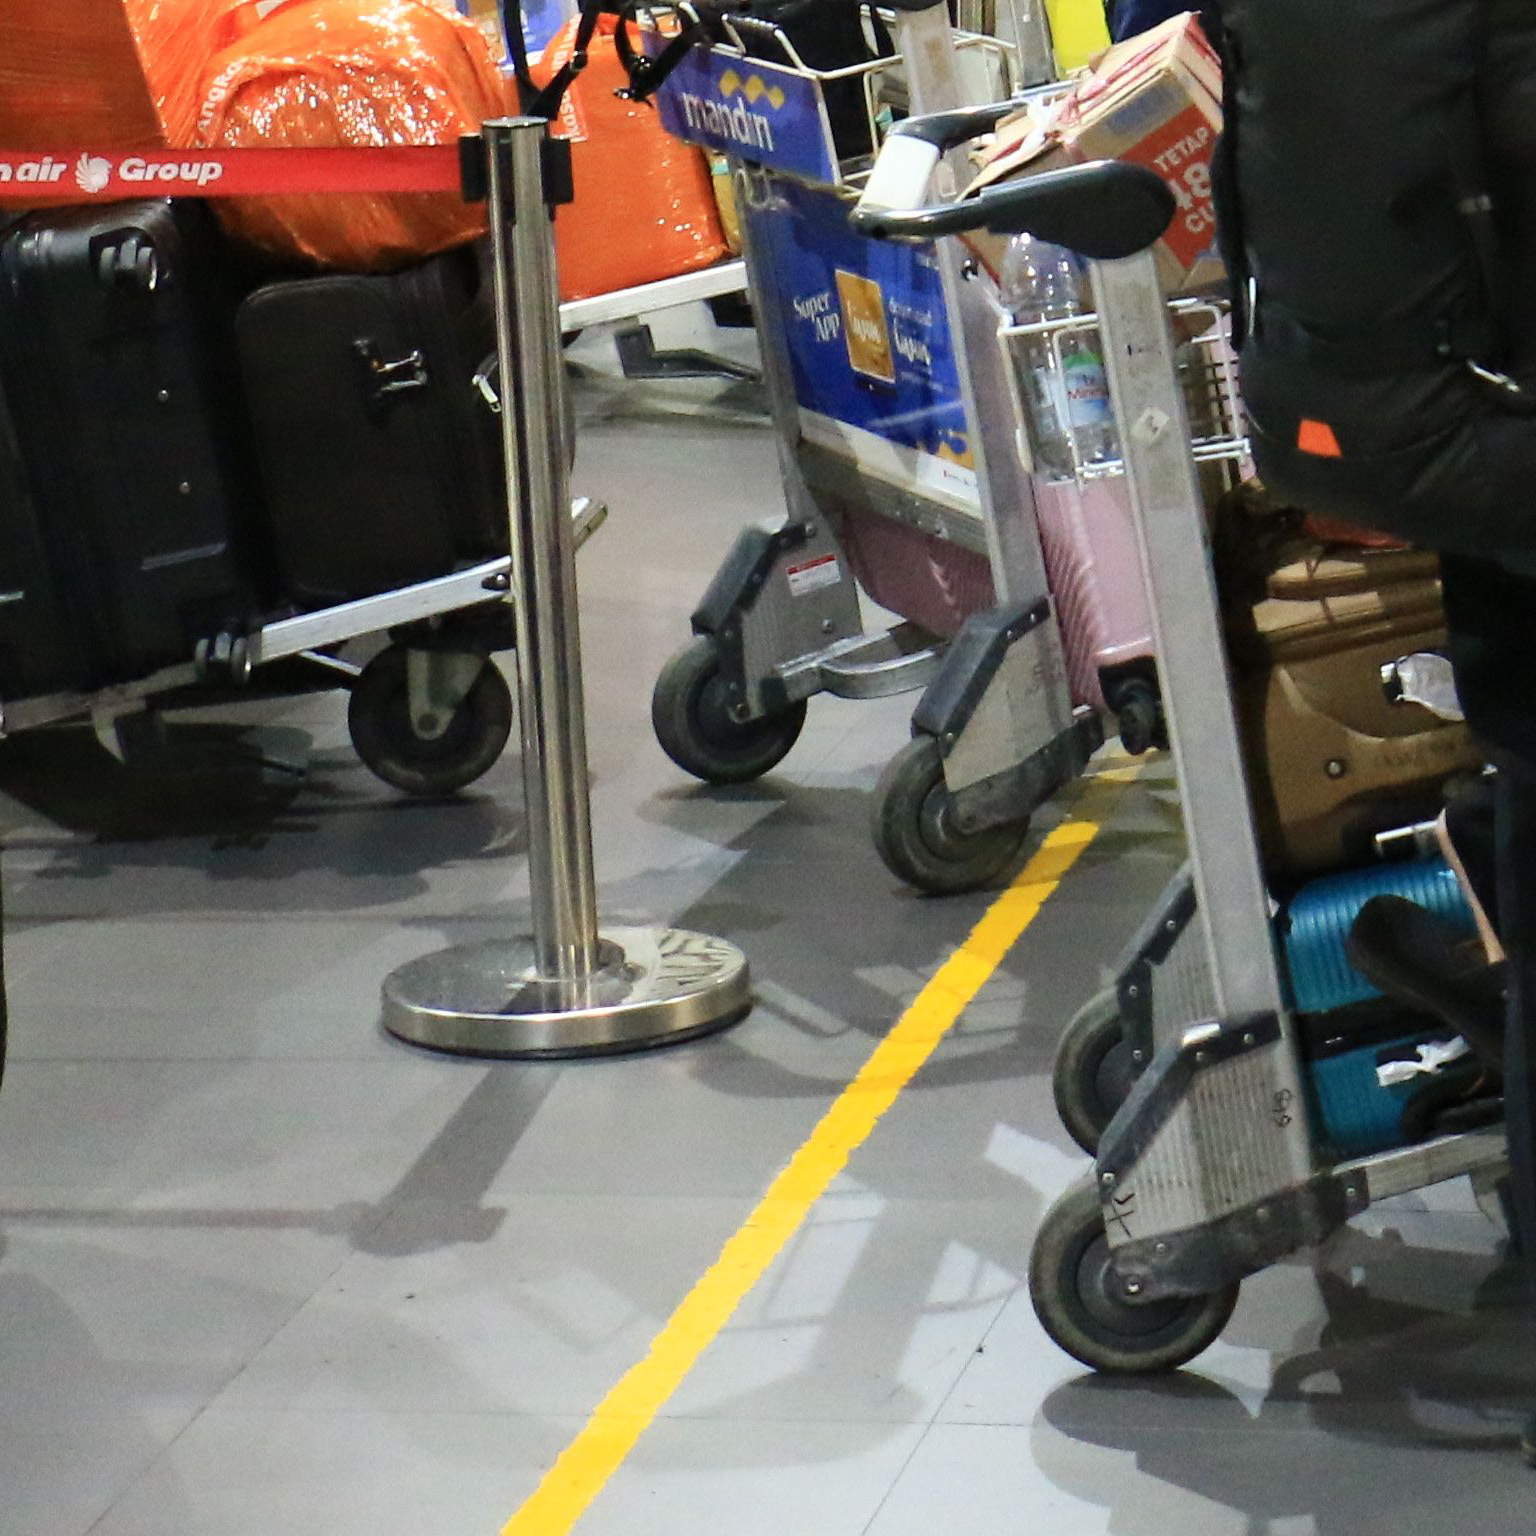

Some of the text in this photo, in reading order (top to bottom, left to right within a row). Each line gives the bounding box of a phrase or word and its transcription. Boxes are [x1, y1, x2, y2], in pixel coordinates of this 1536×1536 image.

[1153, 126, 1209, 172] TETAP
[16, 156, 67, 182] air
[119, 157, 223, 186] Group
